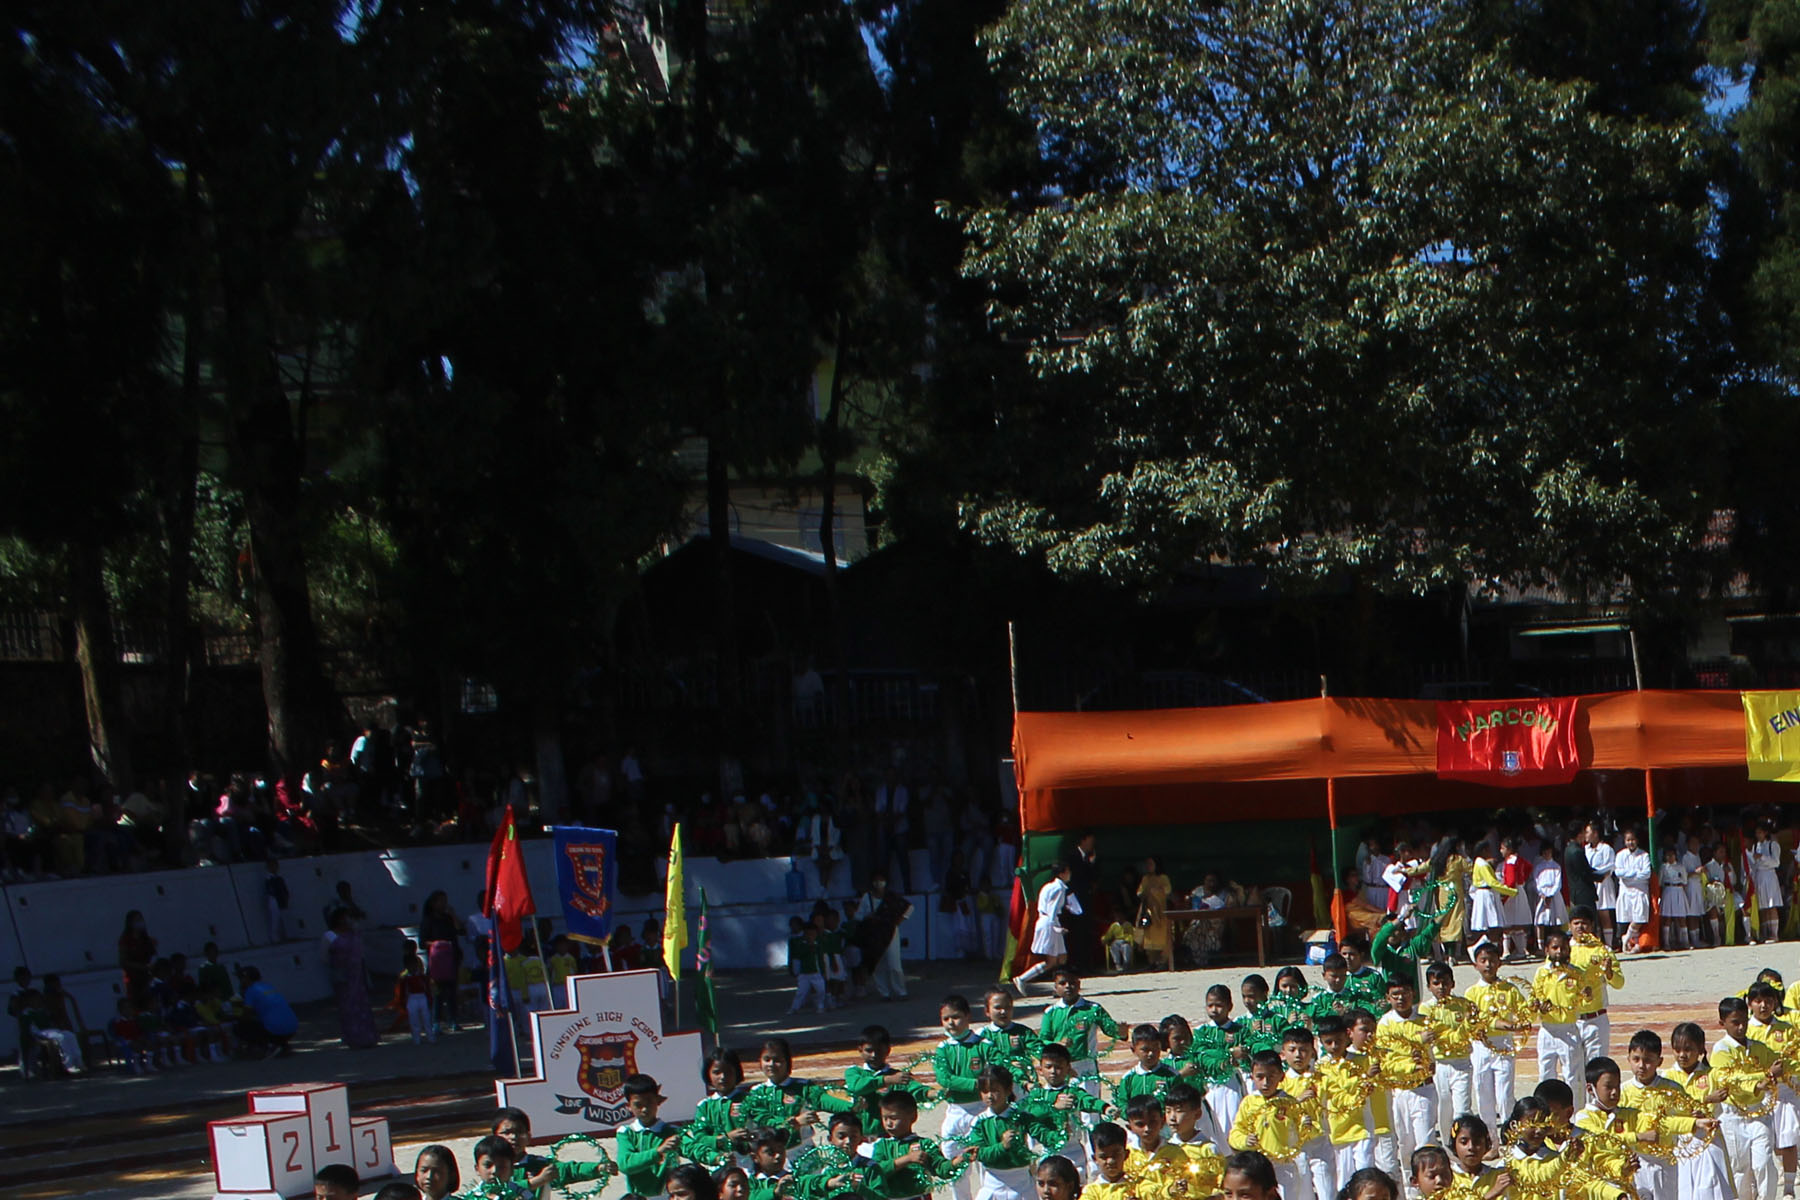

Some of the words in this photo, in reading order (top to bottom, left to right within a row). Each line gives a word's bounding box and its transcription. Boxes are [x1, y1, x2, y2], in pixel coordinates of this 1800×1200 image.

[1456, 708, 1559, 742] MARCONI
[550, 1016, 592, 1061] SUNSHINE
[596, 1011, 623, 1023] HIGH
[630, 1016, 663, 1051] SCHOOL
[325, 1111, 340, 1152] 1
[588, 1106, 630, 1122] WISDO
[283, 1131, 302, 1172] 2
[362, 1129, 380, 1168] 3
